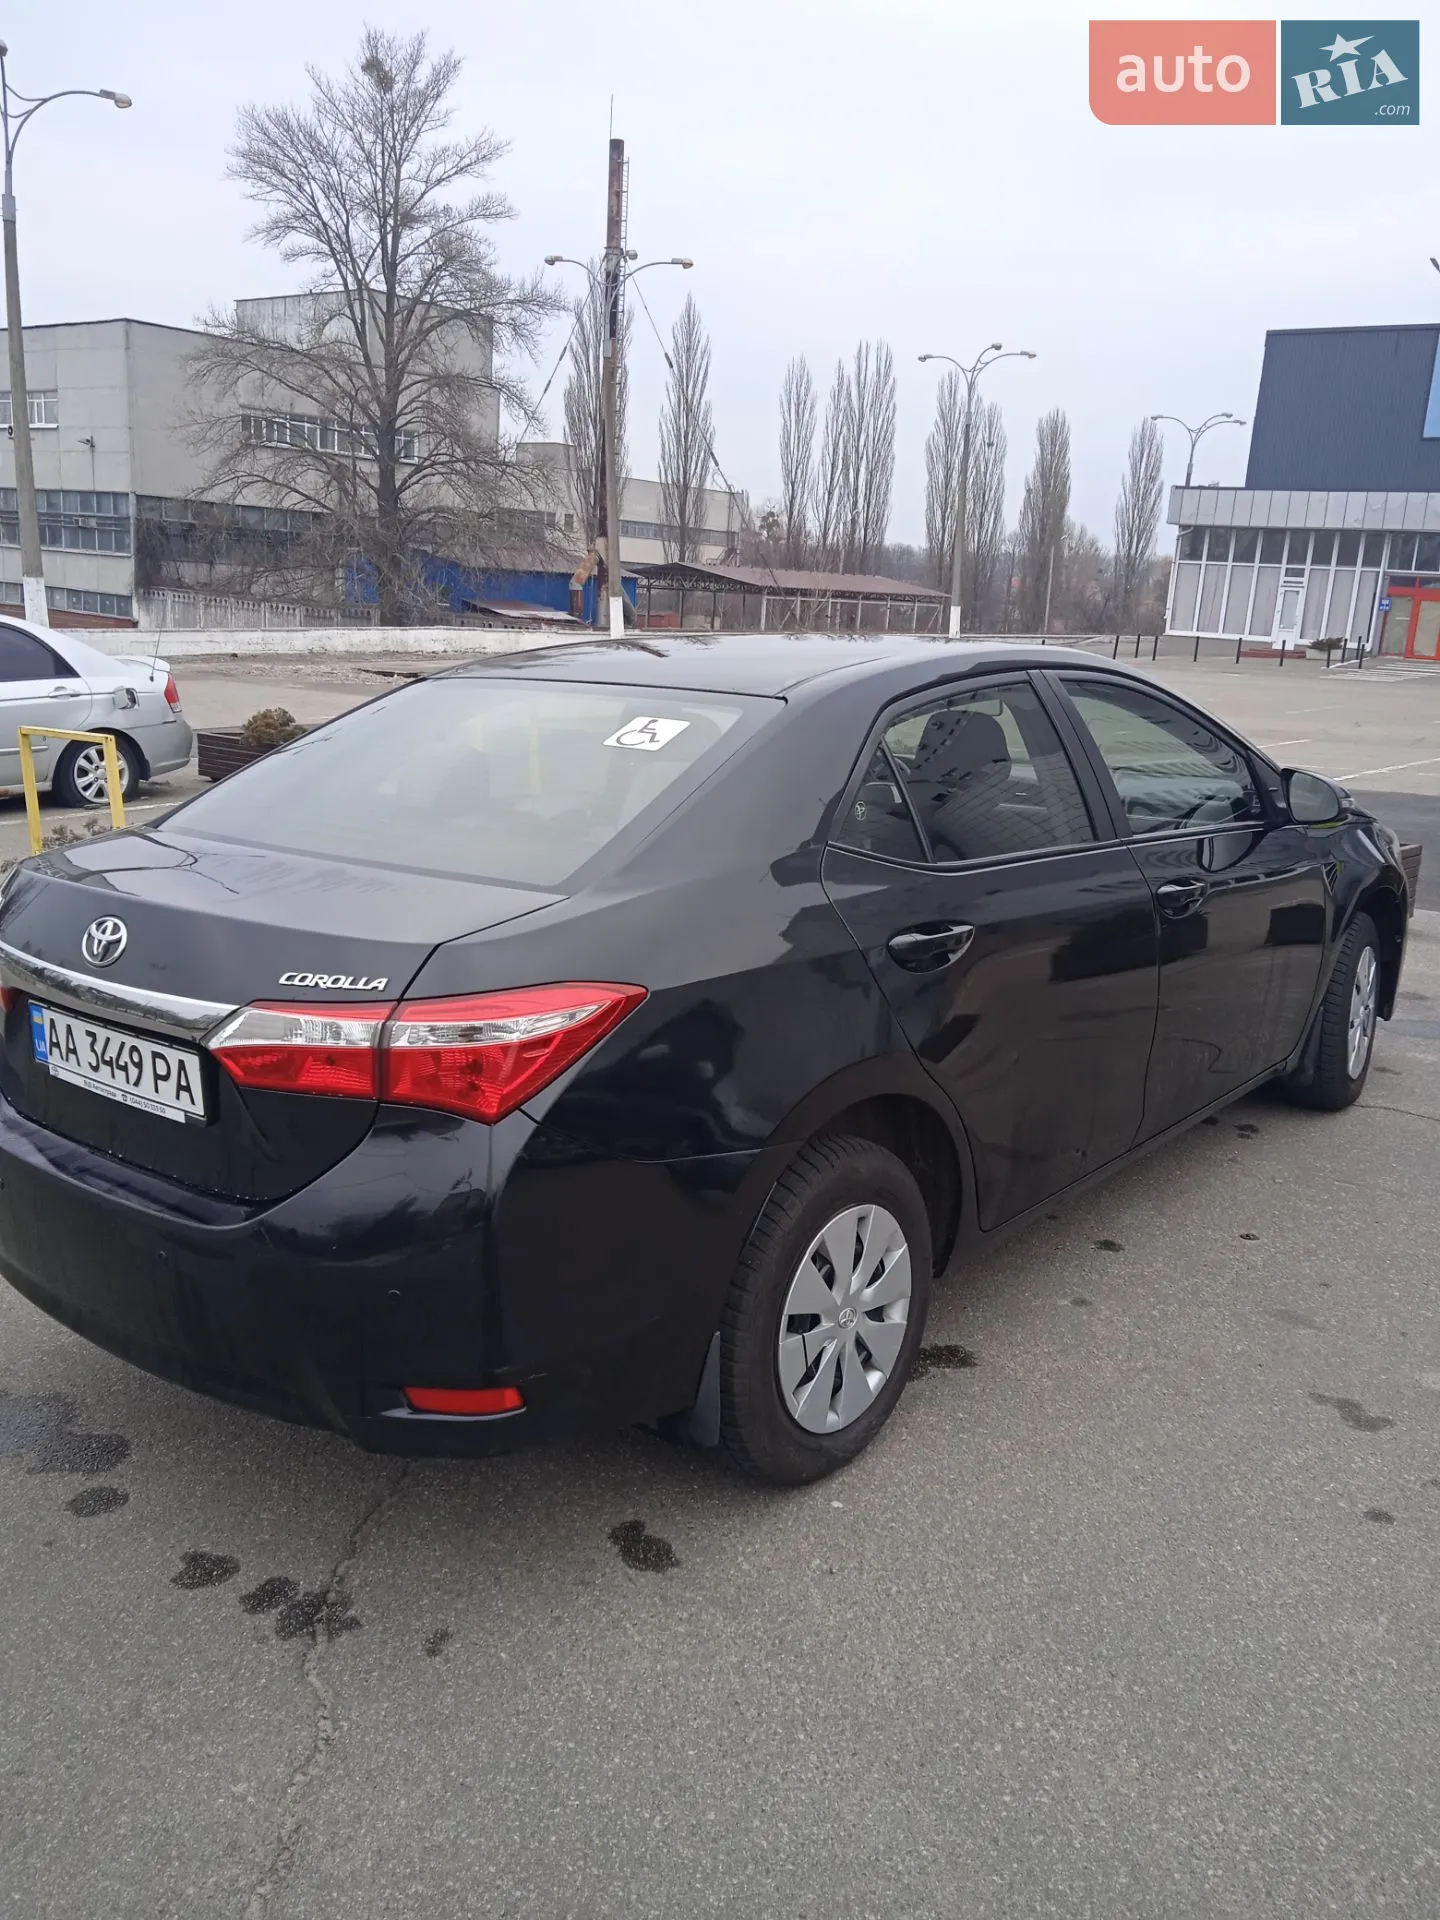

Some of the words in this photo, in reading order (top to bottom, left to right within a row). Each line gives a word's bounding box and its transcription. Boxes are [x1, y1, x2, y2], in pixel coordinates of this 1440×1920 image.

[278, 972, 389, 991] COROLLA
[34, 1039, 47, 1054] UA
[48, 1017, 81, 1067] AA
[85, 1029, 143, 1087] 3449
[151, 1050, 196, 1106] PA
